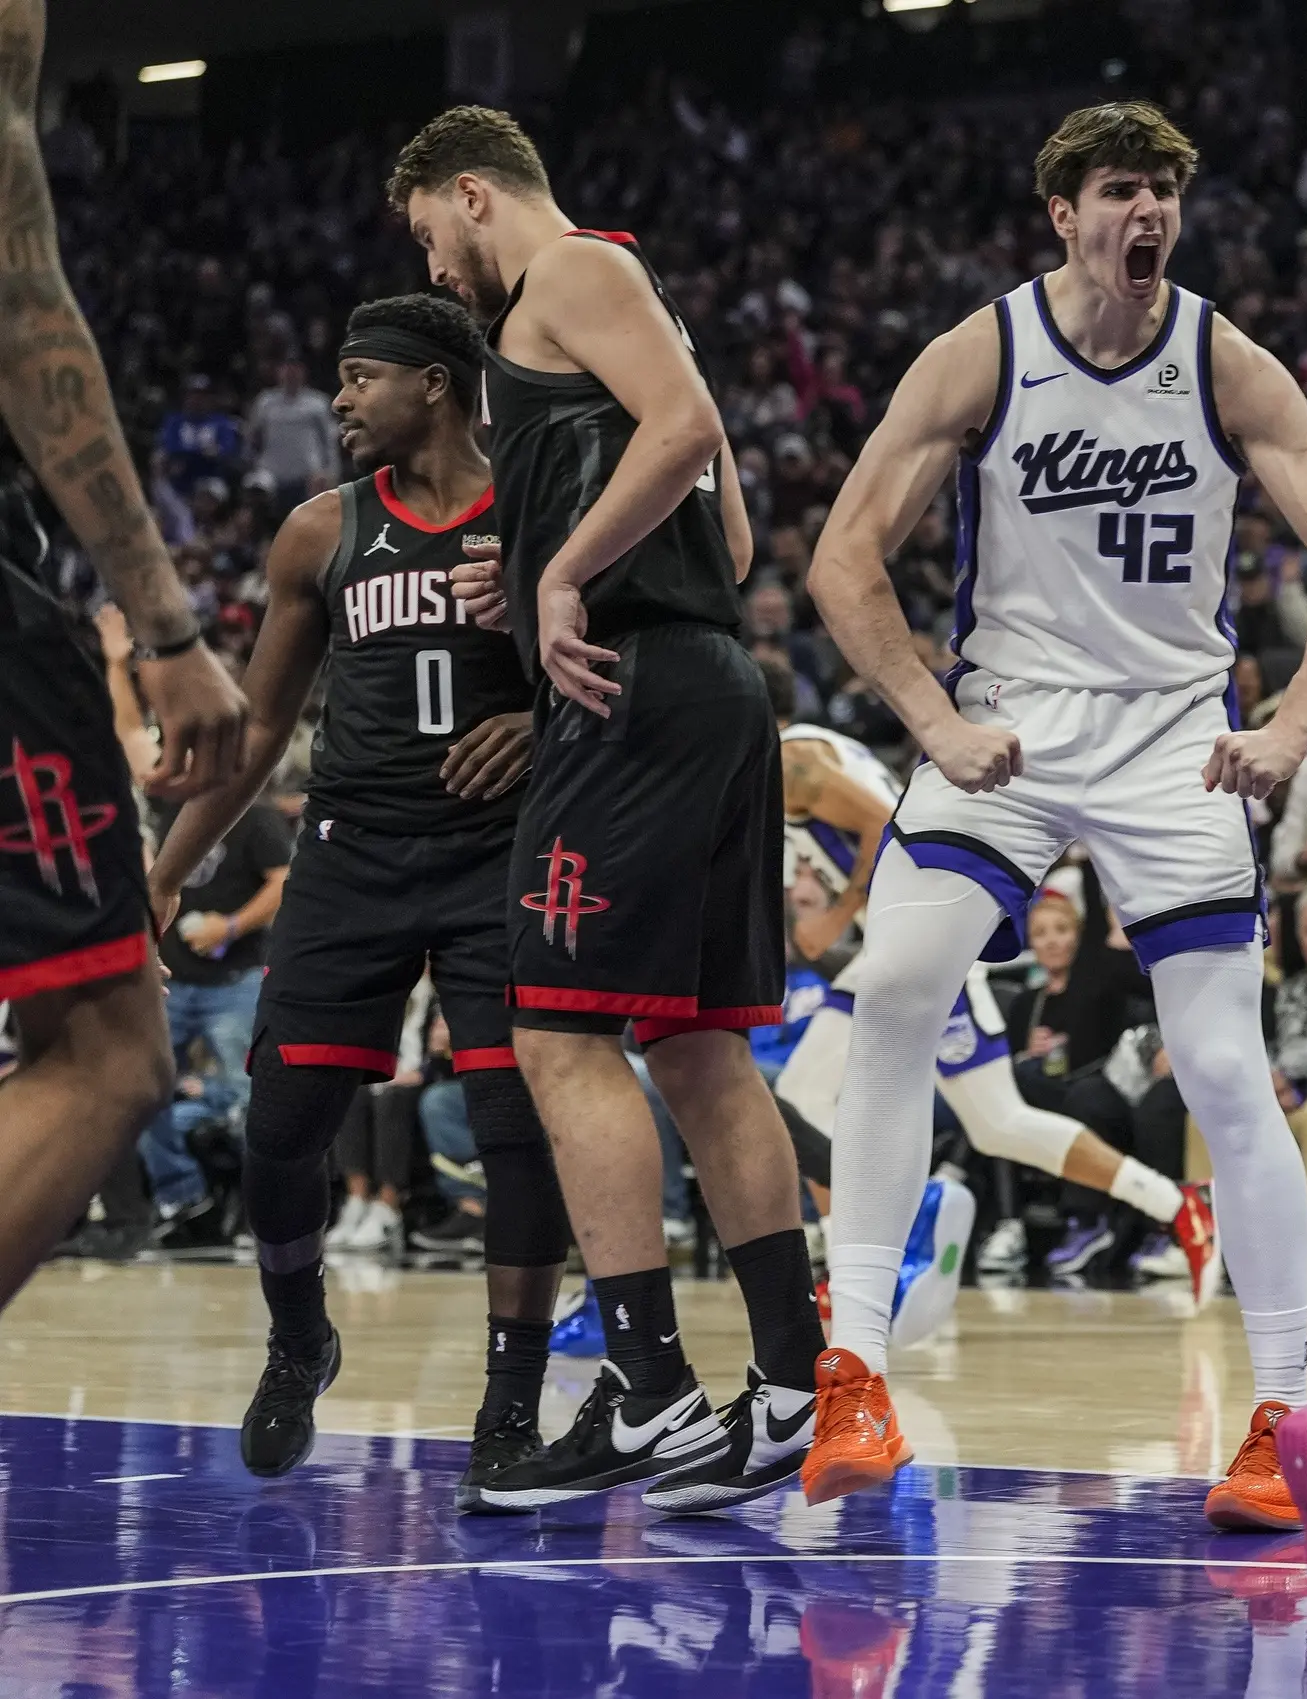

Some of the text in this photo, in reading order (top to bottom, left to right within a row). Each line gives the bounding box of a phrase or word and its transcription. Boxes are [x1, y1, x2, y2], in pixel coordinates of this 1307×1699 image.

[1011, 429, 1198, 512] Kings
[1098, 512, 1195, 583] 42
[344, 570, 467, 644] HOUS
[415, 649, 454, 735] 0
